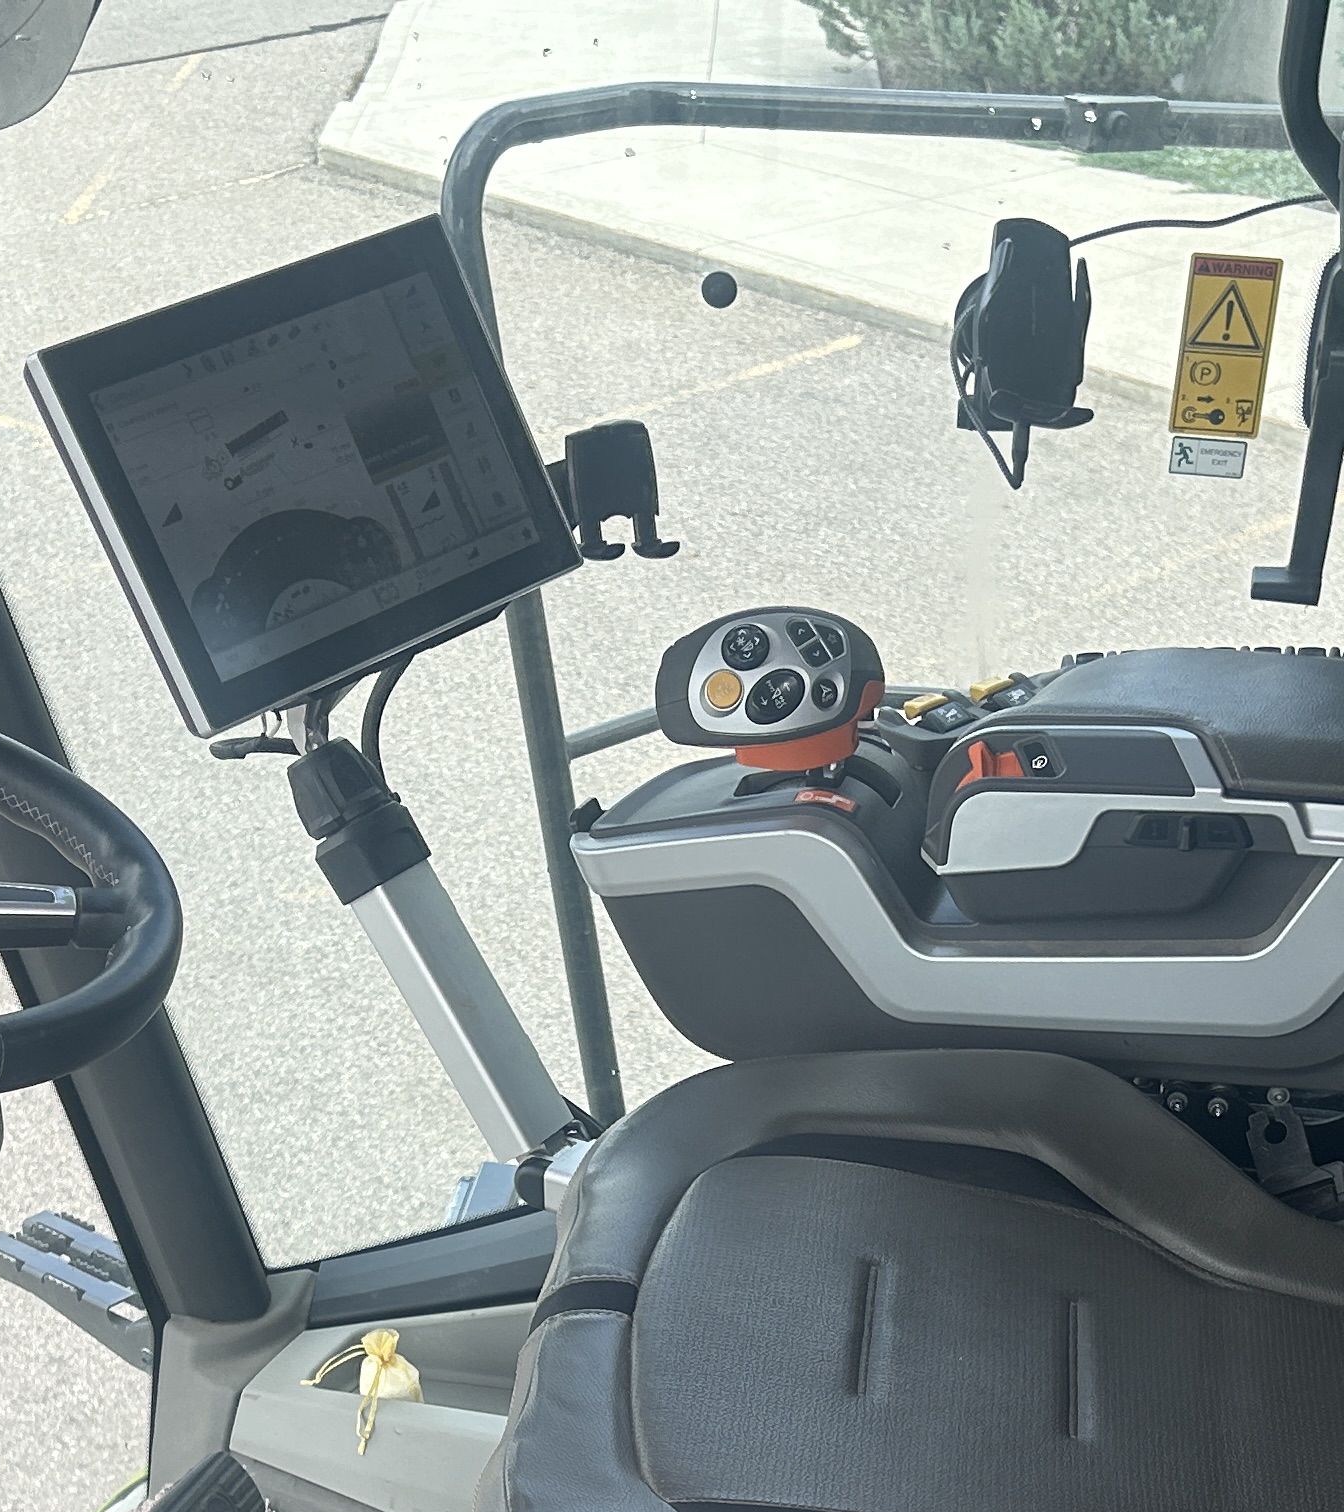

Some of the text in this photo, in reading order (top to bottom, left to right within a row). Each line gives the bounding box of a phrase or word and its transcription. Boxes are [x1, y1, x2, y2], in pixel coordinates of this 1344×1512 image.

[1212, 261, 1274, 278] WARNING
[1200, 366, 1212, 381] P
[1200, 448, 1243, 458] EMERGENCY
[1211, 458, 1228, 466] EXIT
